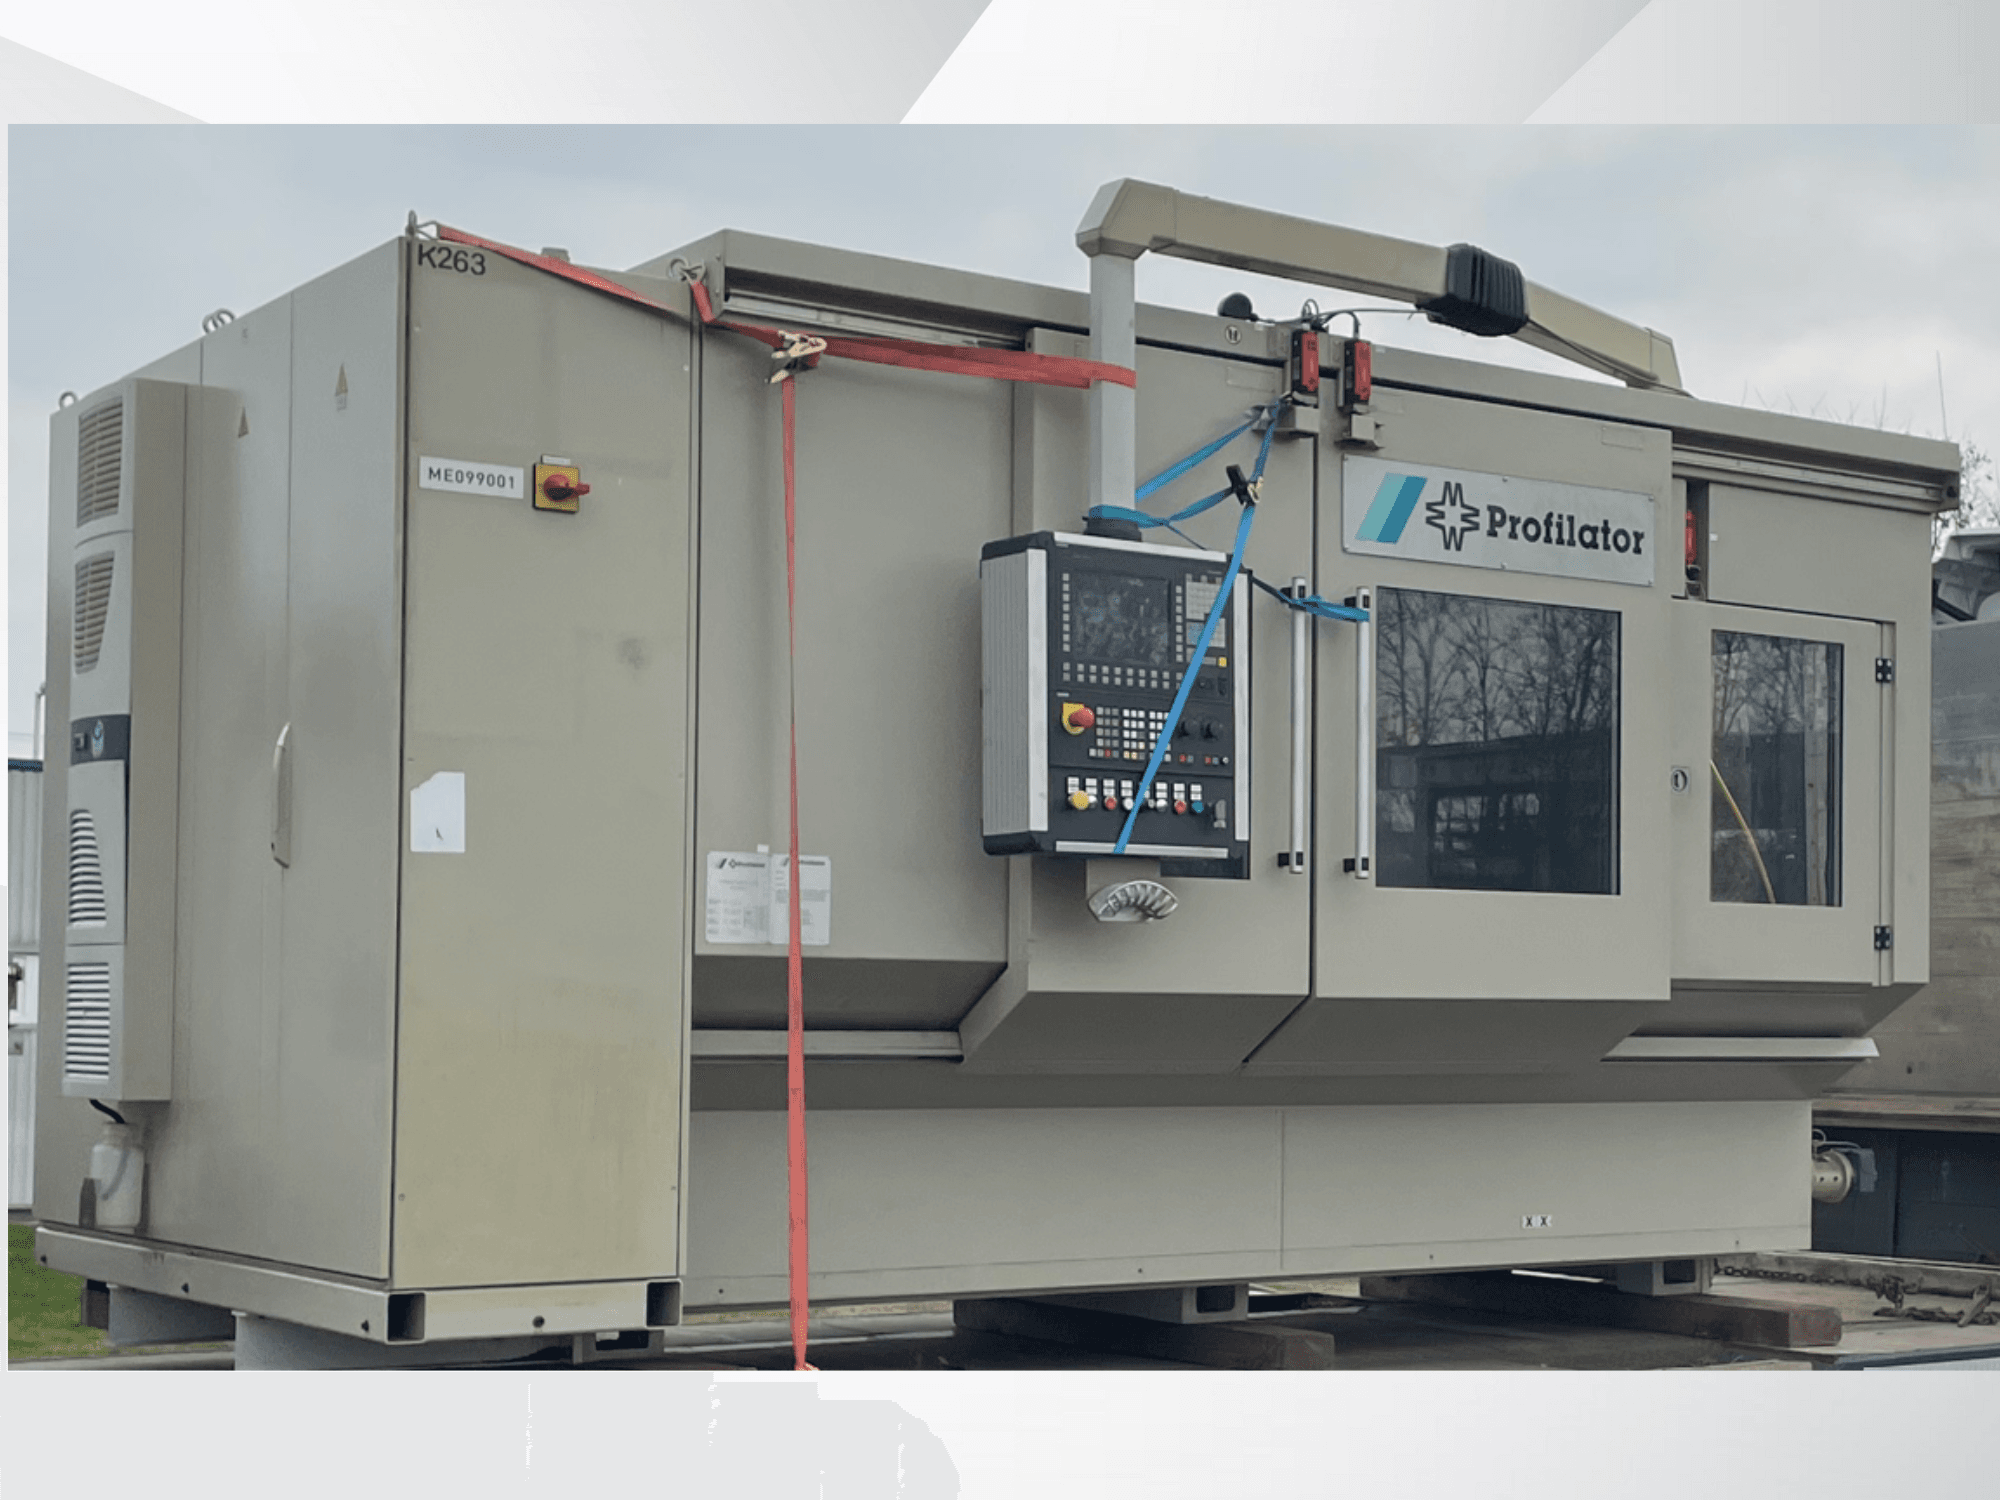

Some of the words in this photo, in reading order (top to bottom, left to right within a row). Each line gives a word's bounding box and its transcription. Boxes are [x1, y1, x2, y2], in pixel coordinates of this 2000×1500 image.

[418, 243, 486, 276] K263
[428, 466, 515, 490] ME099001
[1486, 504, 1645, 555] Profilator
